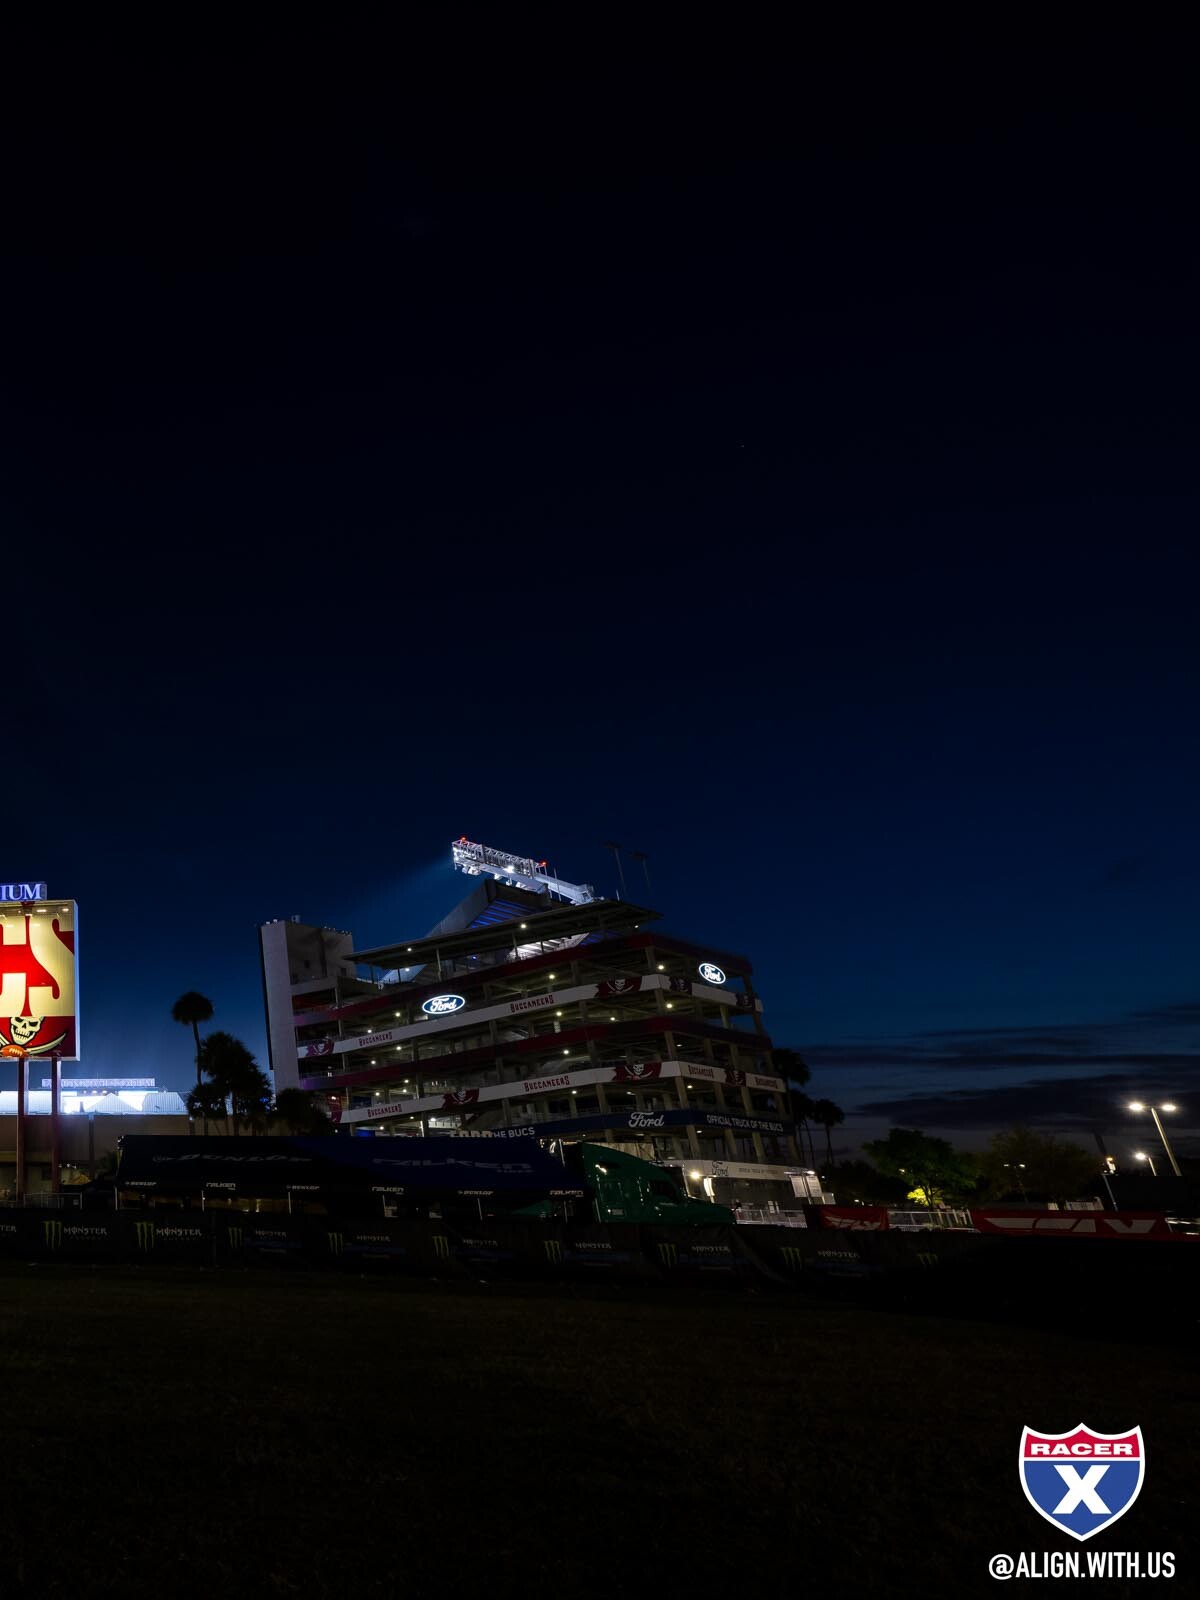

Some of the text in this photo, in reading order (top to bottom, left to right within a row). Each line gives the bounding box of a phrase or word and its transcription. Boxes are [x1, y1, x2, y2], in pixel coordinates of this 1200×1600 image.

[429, 997, 458, 1012] Ford
[628, 1111, 664, 1128] Ford
[508, 1126, 535, 1138] BUCS
[63, 1225, 107, 1236] MONSTER
[155, 1226, 201, 1237] MONSTER
